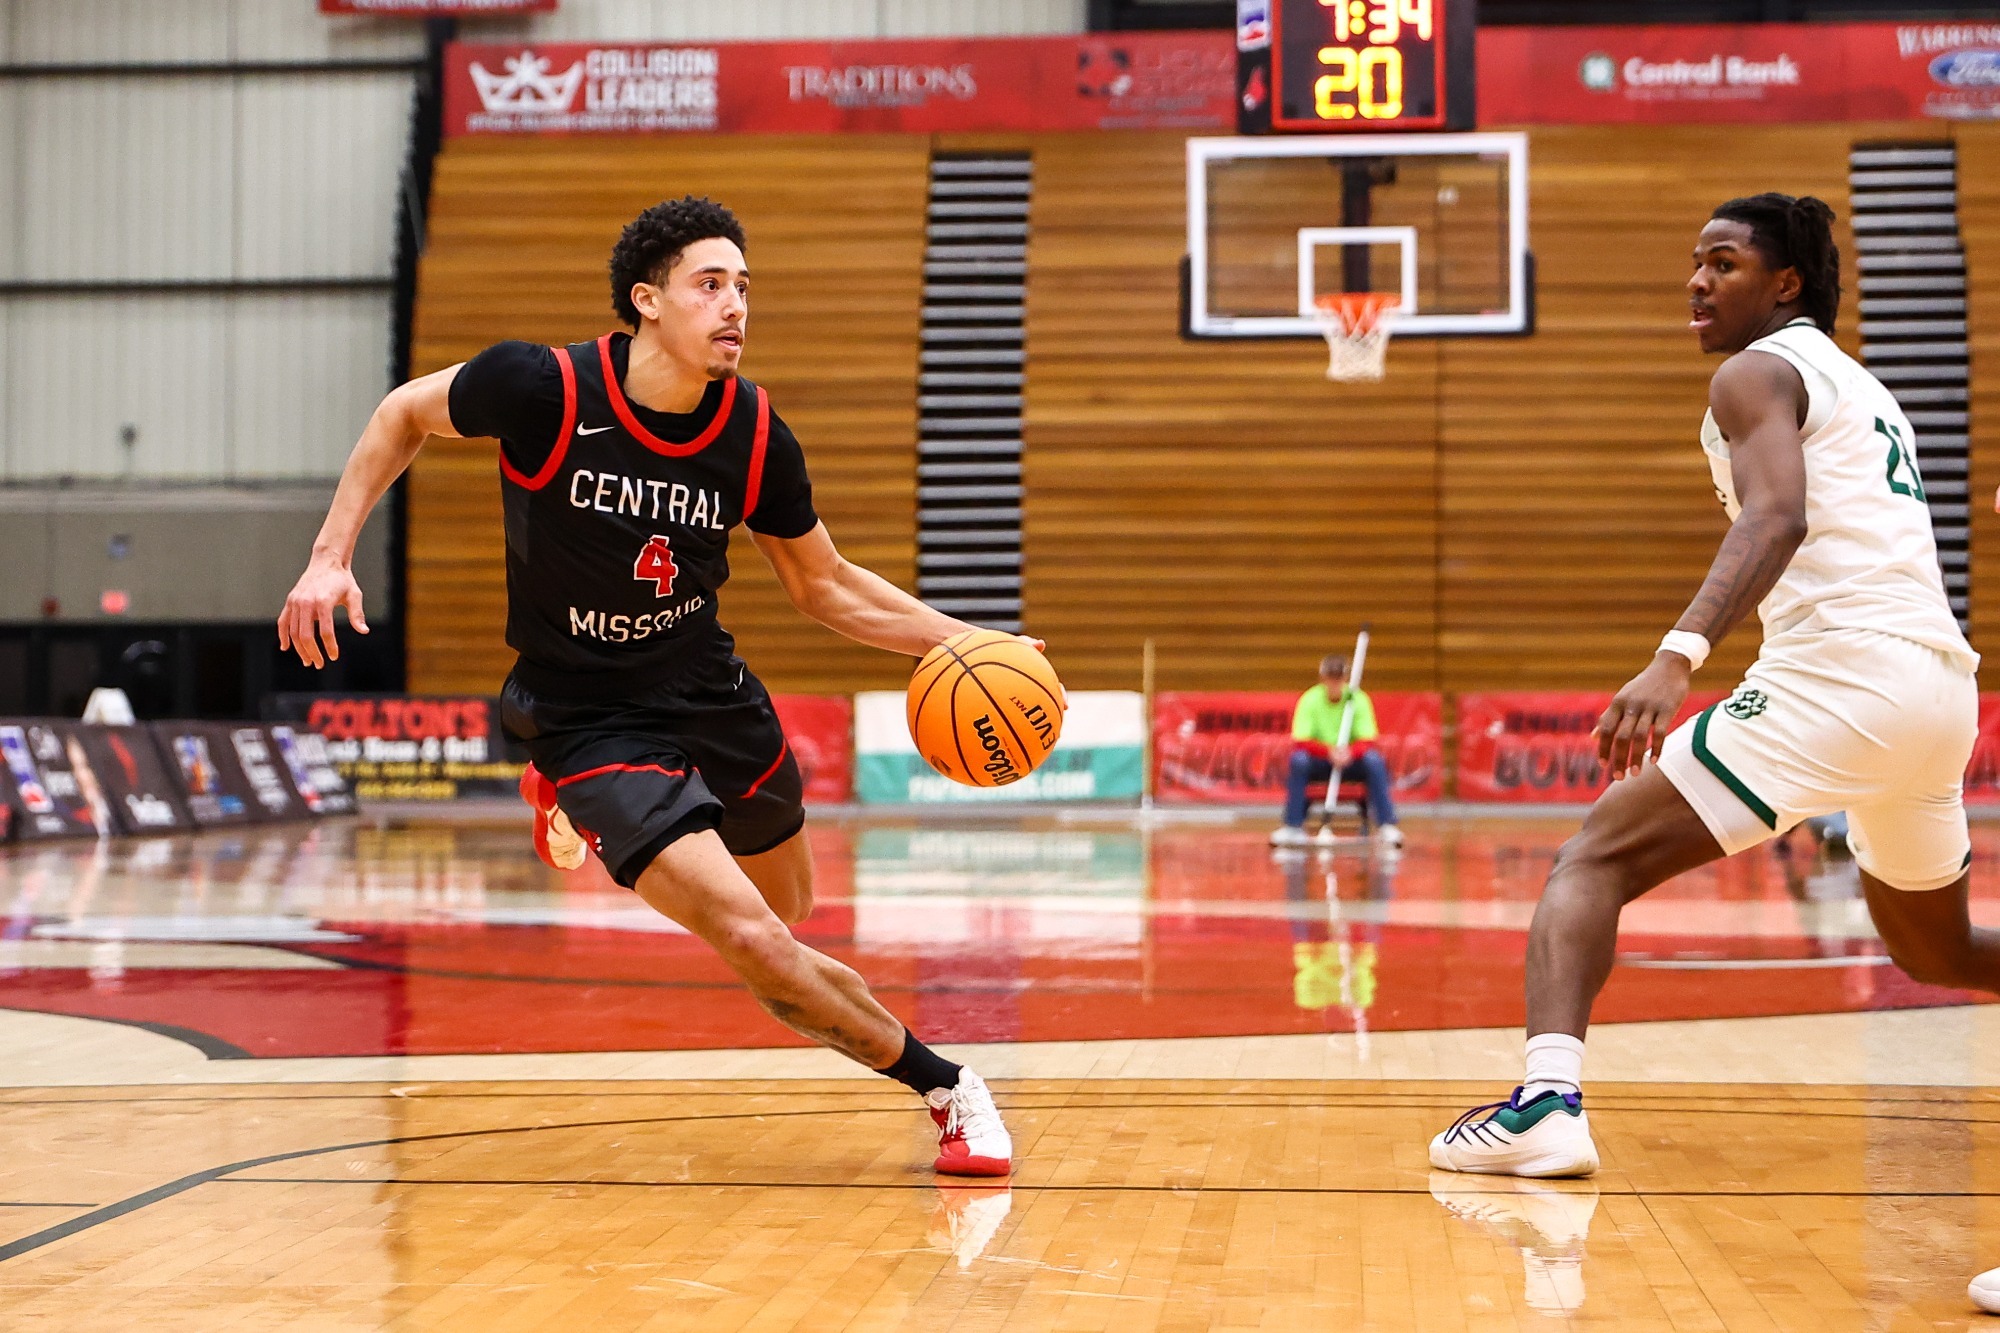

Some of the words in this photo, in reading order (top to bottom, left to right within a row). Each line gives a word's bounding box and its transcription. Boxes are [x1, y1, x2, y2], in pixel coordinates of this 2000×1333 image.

[1317, 0, 1432, 44] 7:34
[585, 49, 719, 78] COLLISION
[782, 63, 978, 101] TRADITIONS
[1623, 54, 1722, 86] Central
[1725, 53, 1799, 85] Bank
[585, 78, 719, 112] LEADERS
[1315, 47, 1402, 119] 20
[570, 469, 724, 530] CENTRAL
[634, 534, 679, 598] 4
[1008, 696, 1028, 712] NXT
